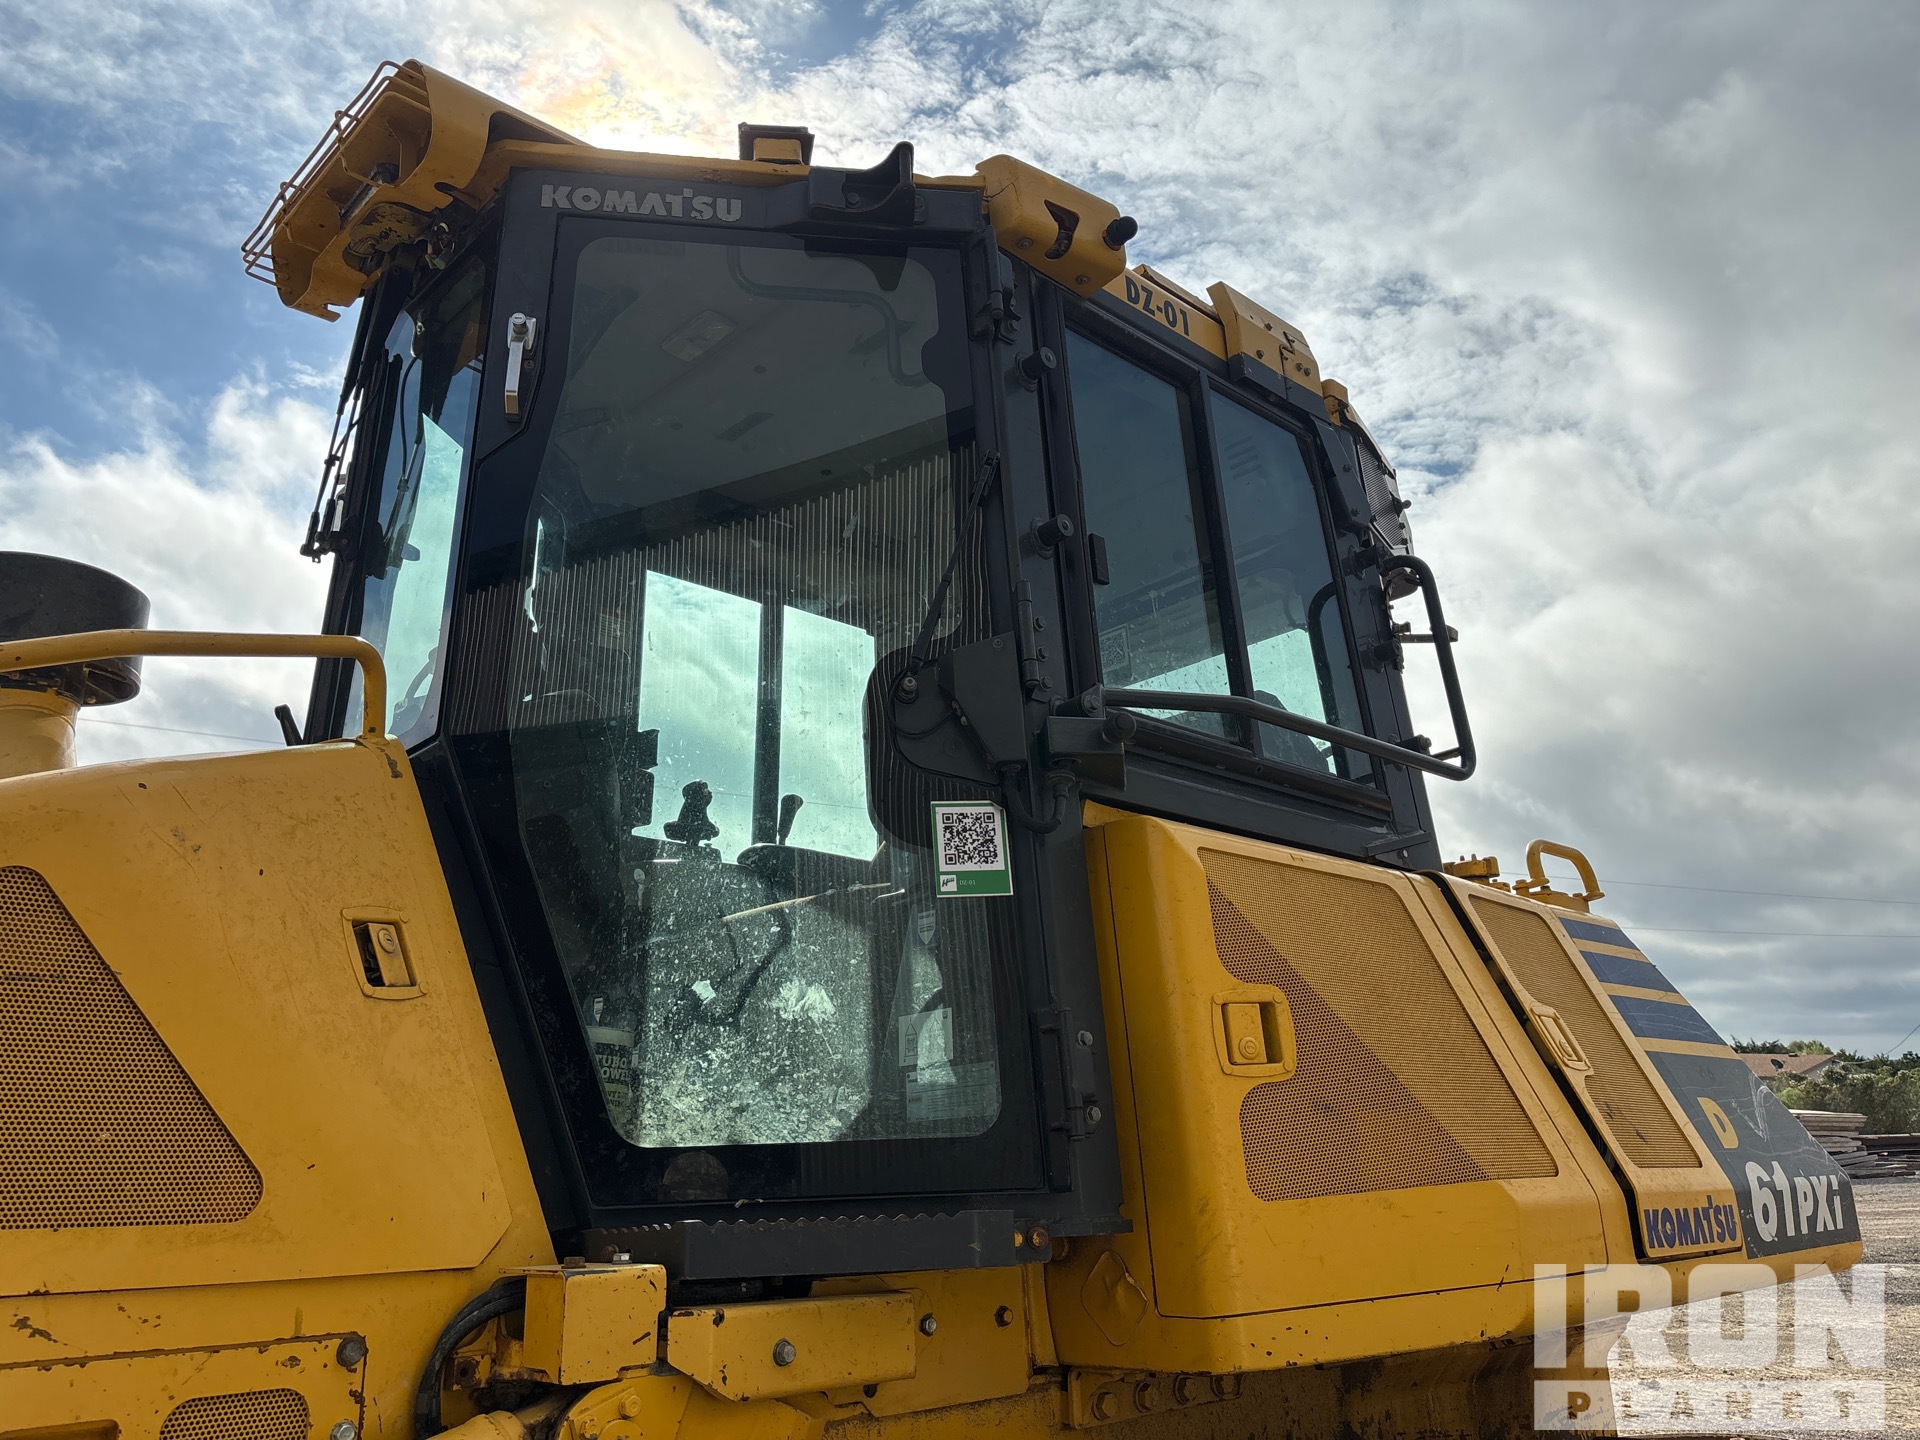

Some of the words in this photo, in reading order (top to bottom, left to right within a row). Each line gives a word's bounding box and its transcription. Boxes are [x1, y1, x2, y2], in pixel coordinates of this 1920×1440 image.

[540, 184, 742, 222] KOMATSU
[1125, 274, 1190, 337] DZ-01
[1696, 1096, 1739, 1149] D
[1643, 1195, 1738, 1249] KOMATSU
